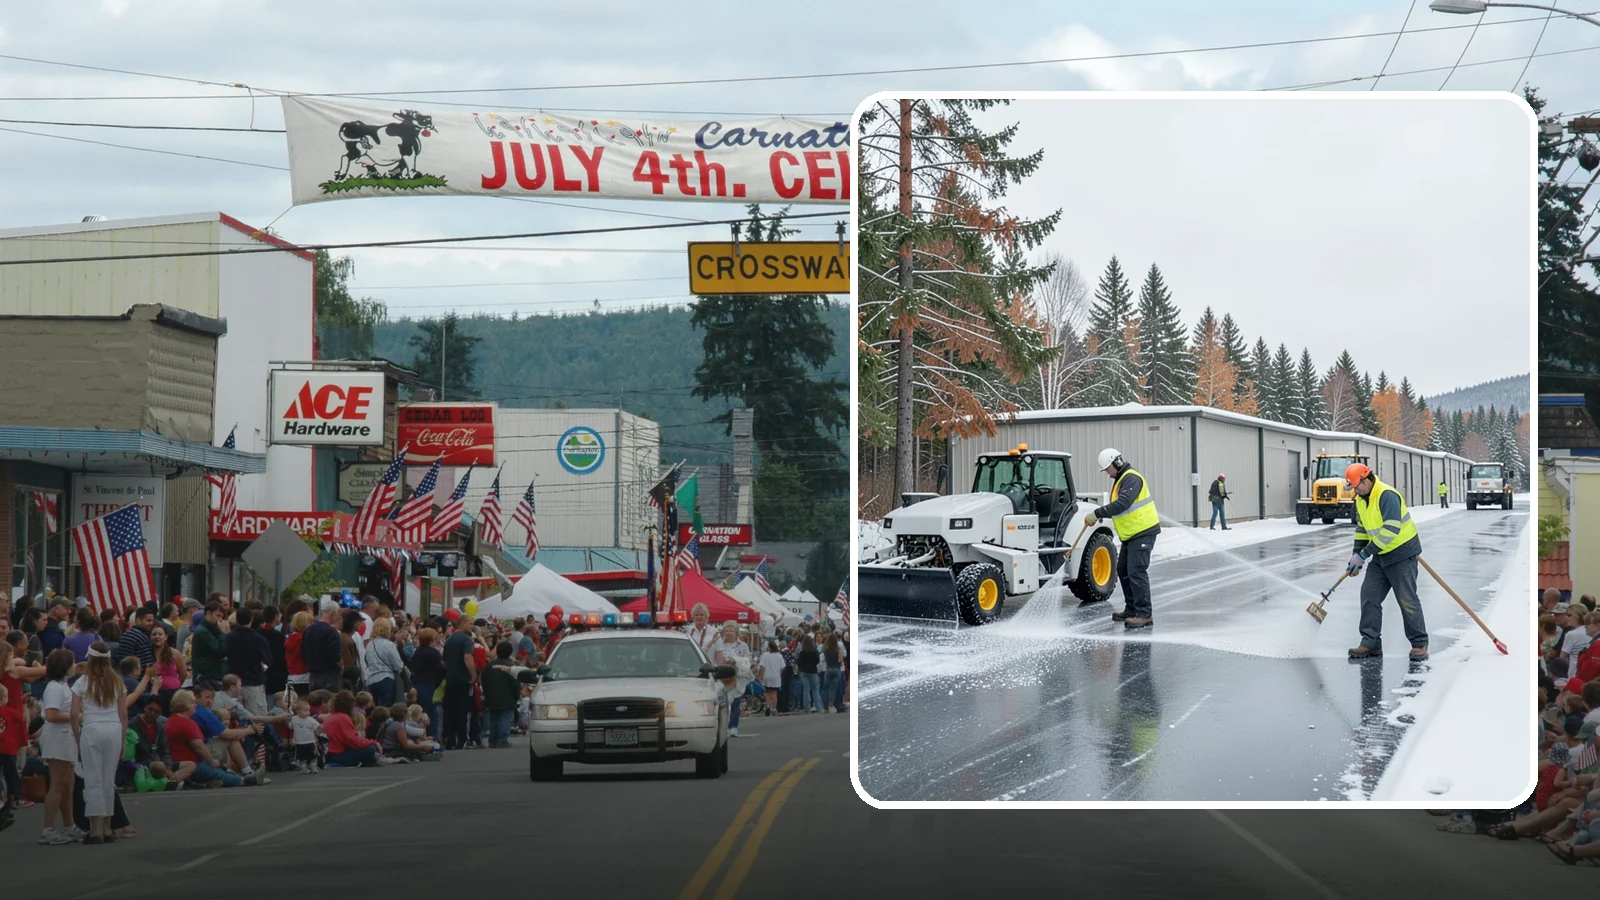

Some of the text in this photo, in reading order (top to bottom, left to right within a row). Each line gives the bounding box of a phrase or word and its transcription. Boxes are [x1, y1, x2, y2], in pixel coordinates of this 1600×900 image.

[481, 141, 604, 192] JULY
[632, 150, 746, 197] 4th.
[697, 254, 850, 279] CROSSWA
[283, 380, 373, 420] ACE
[406, 409, 451, 421] CEDAR
[284, 421, 370, 436] Hardware
[354, 467, 386, 480] Simpl
[83, 485, 155, 495] St. Vincent de Paul
[81, 503, 153, 522] THT
[688, 526, 741, 535] CRNATION
[699, 535, 730, 543] GLASS
